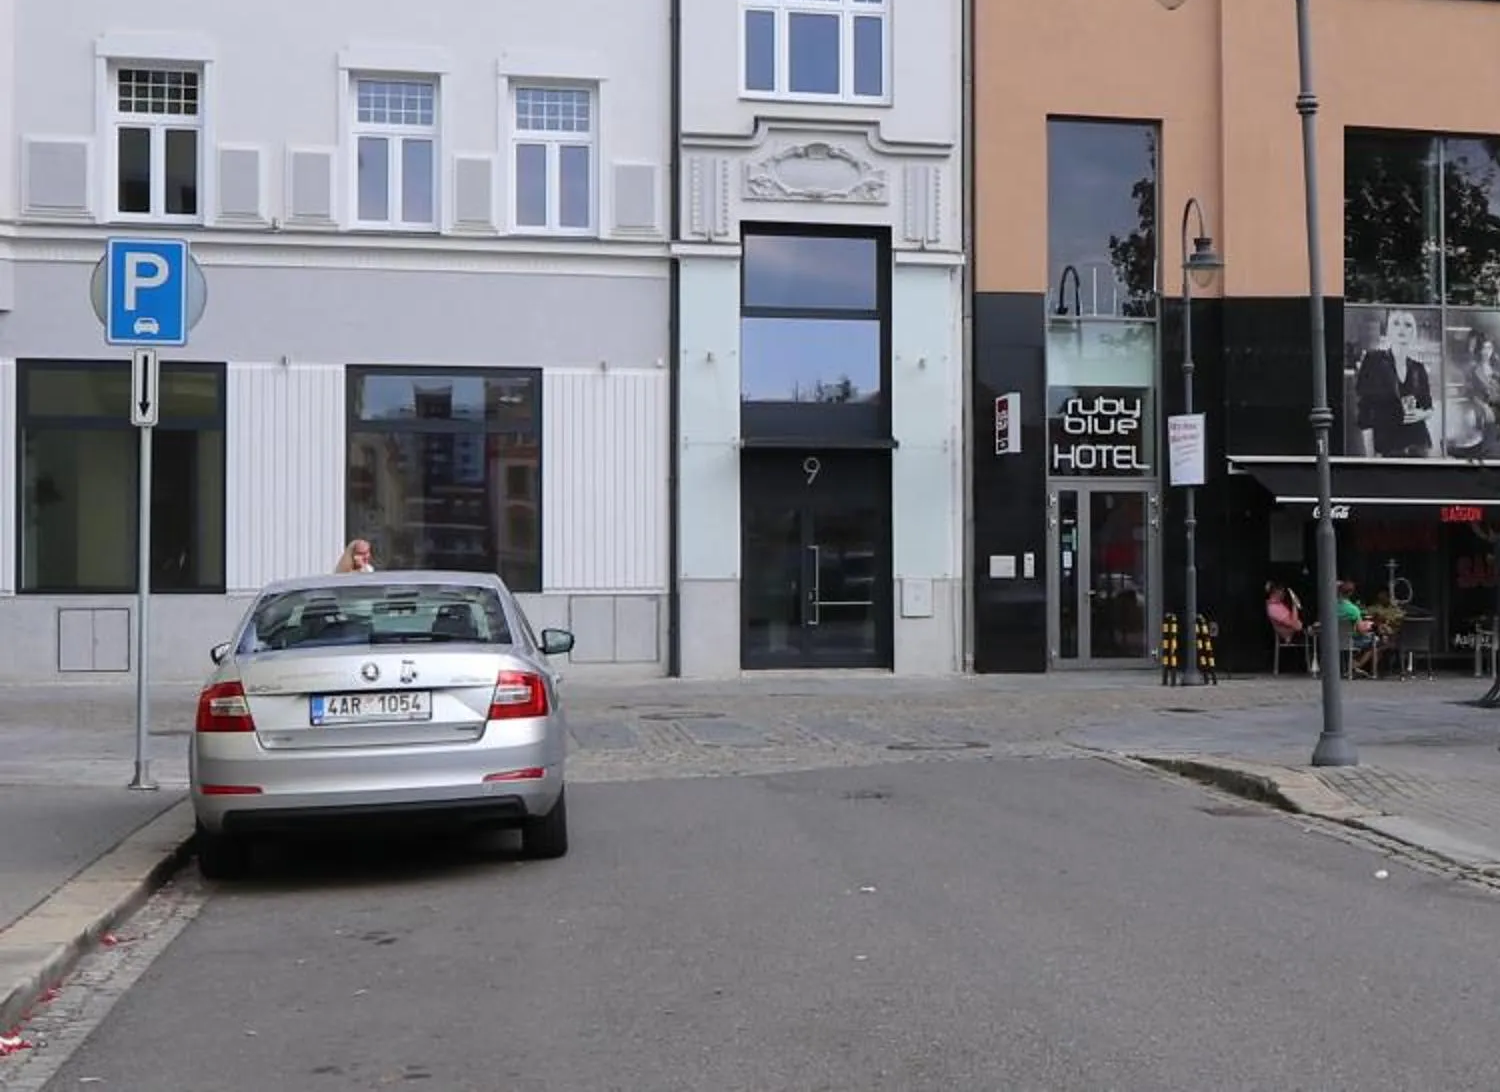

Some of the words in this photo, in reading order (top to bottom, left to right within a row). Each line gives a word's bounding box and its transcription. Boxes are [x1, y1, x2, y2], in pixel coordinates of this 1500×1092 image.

[124, 252, 170, 311] P
[1067, 395, 1142, 418] ruby
[1063, 414, 1138, 435] blue
[1053, 444, 1151, 469] HOTEL
[803, 457, 821, 485] 9
[327, 696, 362, 715] 4AR
[378, 694, 422, 712] 1054
